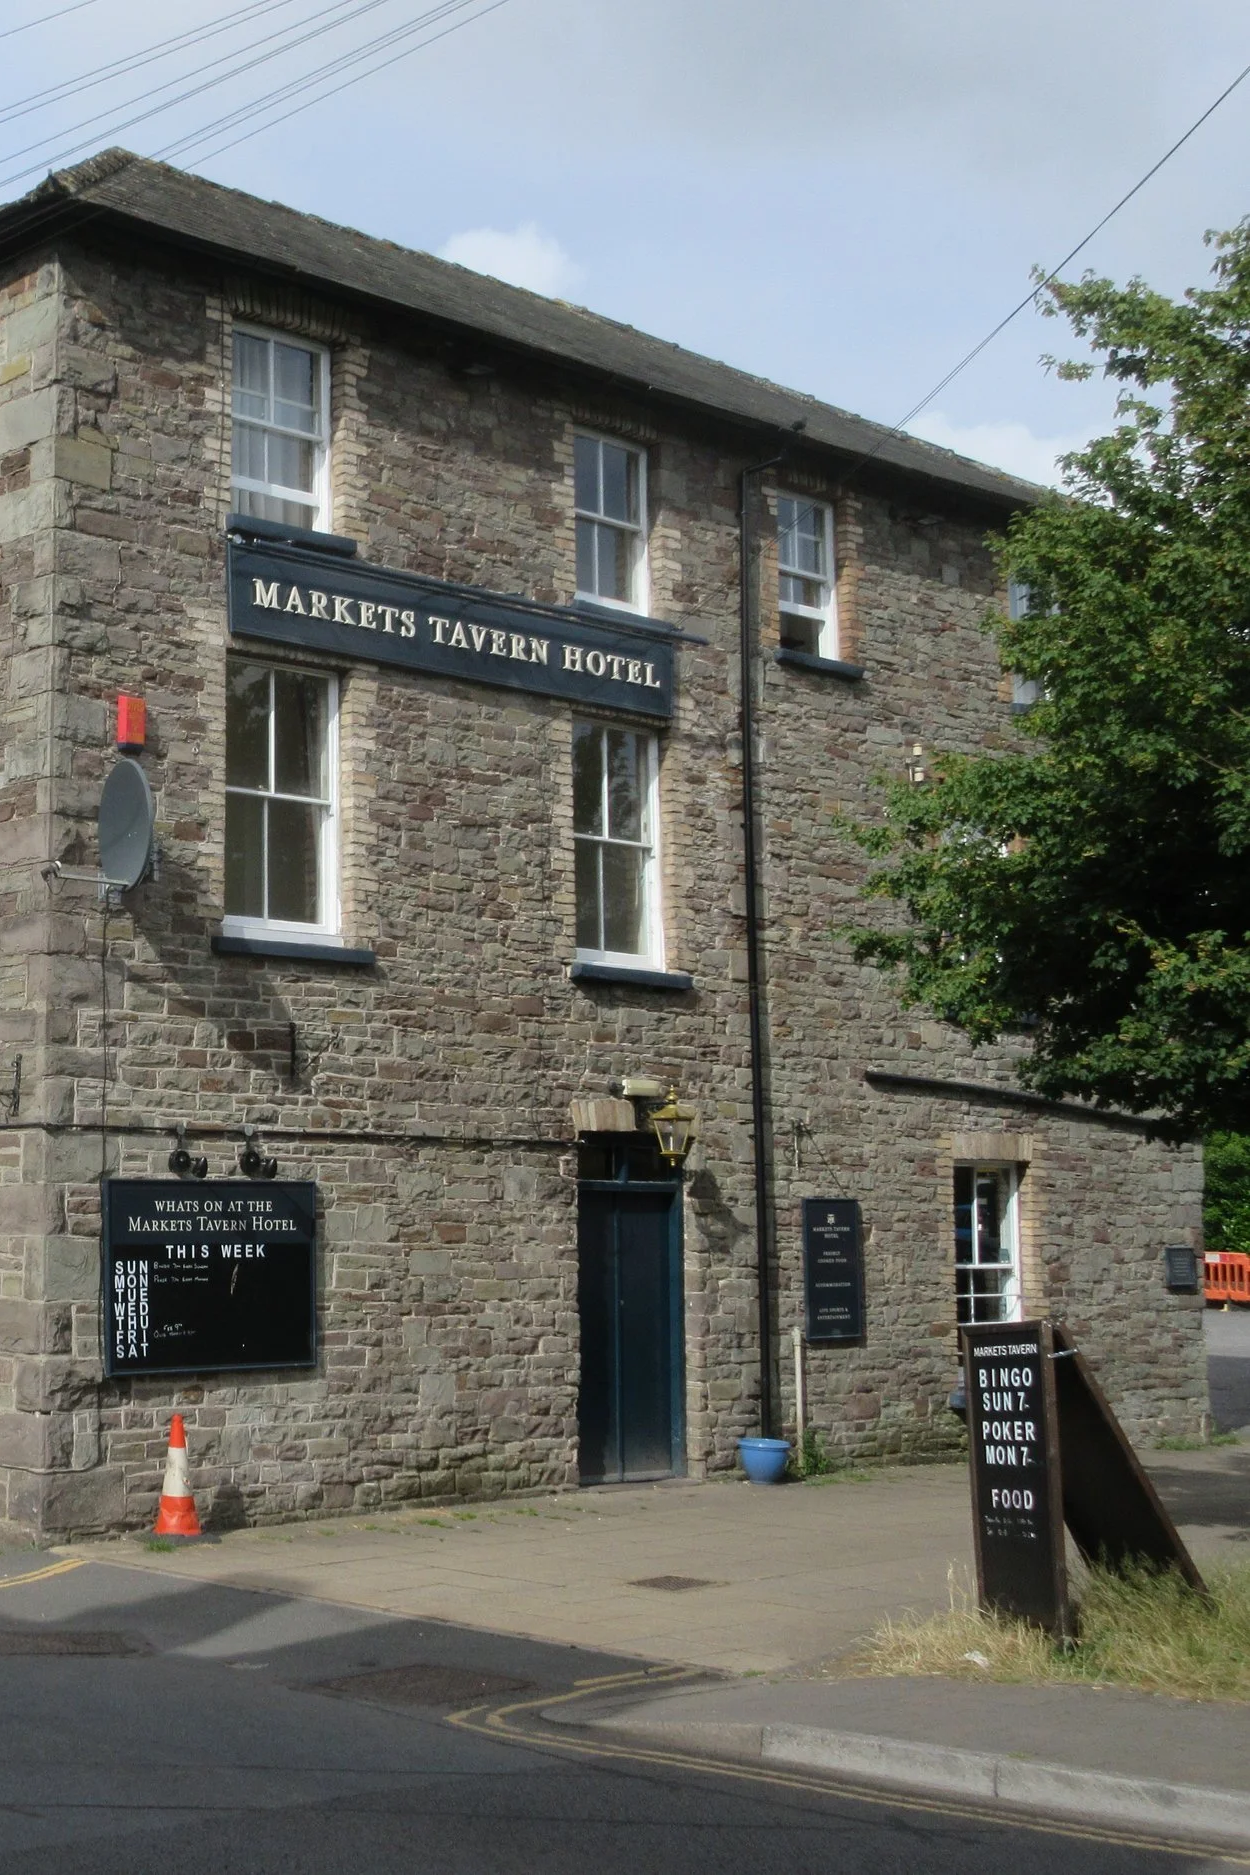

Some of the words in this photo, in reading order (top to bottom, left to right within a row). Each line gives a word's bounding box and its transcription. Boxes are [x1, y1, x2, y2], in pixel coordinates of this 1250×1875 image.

[252, 578, 416, 638] MARKETS
[428, 616, 549, 666] TAVERN
[562, 644, 661, 689] HOTEL
[155, 1200, 199, 1212] WHATS
[204, 1200, 223, 1212] ON
[228, 1200, 244, 1212] AT
[247, 1200, 273, 1212] THE
[128, 1216, 192, 1232] MARKETS
[196, 1216, 247, 1231] TAVERN
[252, 1216, 297, 1231] HOTEL
[166, 1245, 209, 1259] THIS
[221, 1244, 265, 1258] WEEK
[115, 1260, 148, 1274] SUN
[114, 1274, 148, 1289] MON
[115, 1288, 148, 1302] TUE
[114, 1302, 149, 1317] WED
[116, 1315, 149, 1330] THU
[116, 1329, 146, 1344] FRI
[116, 1343, 149, 1358] SAT
[973, 1345, 1007, 1357] MARKETS
[1008, 1343, 1038, 1354] TAVERN
[979, 1367, 1032, 1388] BINGO
[982, 1392, 1012, 1411] SUN
[982, 1421, 1036, 1441] POKER
[985, 1445, 1017, 1466] MON
[991, 1489, 1033, 1509] FOOD
